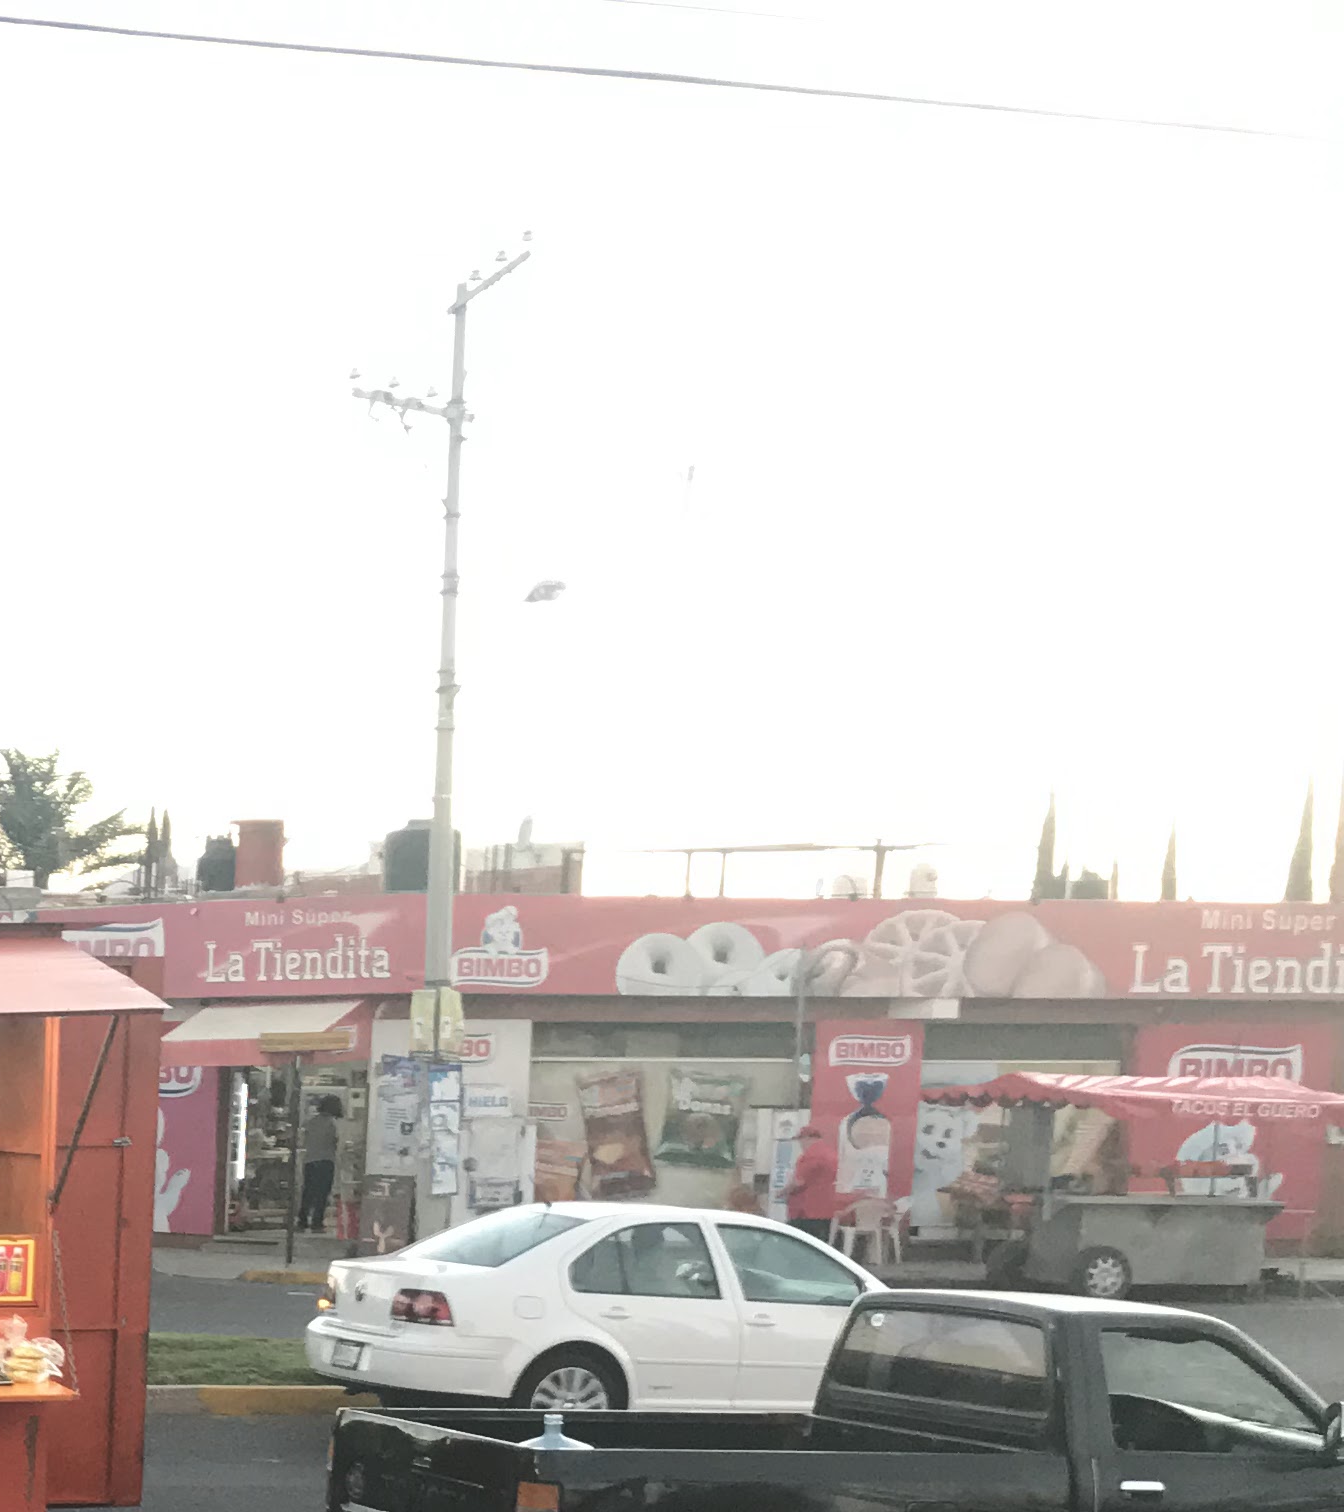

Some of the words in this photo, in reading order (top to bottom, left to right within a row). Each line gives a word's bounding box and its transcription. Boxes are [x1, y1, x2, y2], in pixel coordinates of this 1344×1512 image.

[244, 911, 285, 926] Mini
[1201, 908, 1253, 930] Mini
[1262, 909, 1337, 936] Super
[206, 941, 246, 983] La
[250, 933, 391, 982] Tiendita
[457, 957, 542, 978] BIMBO
[1128, 942, 1191, 993] La
[835, 1042, 905, 1059] BIMBO
[1172, 1099, 1229, 1115] TACOS
[1232, 1102, 1254, 1116] EL
